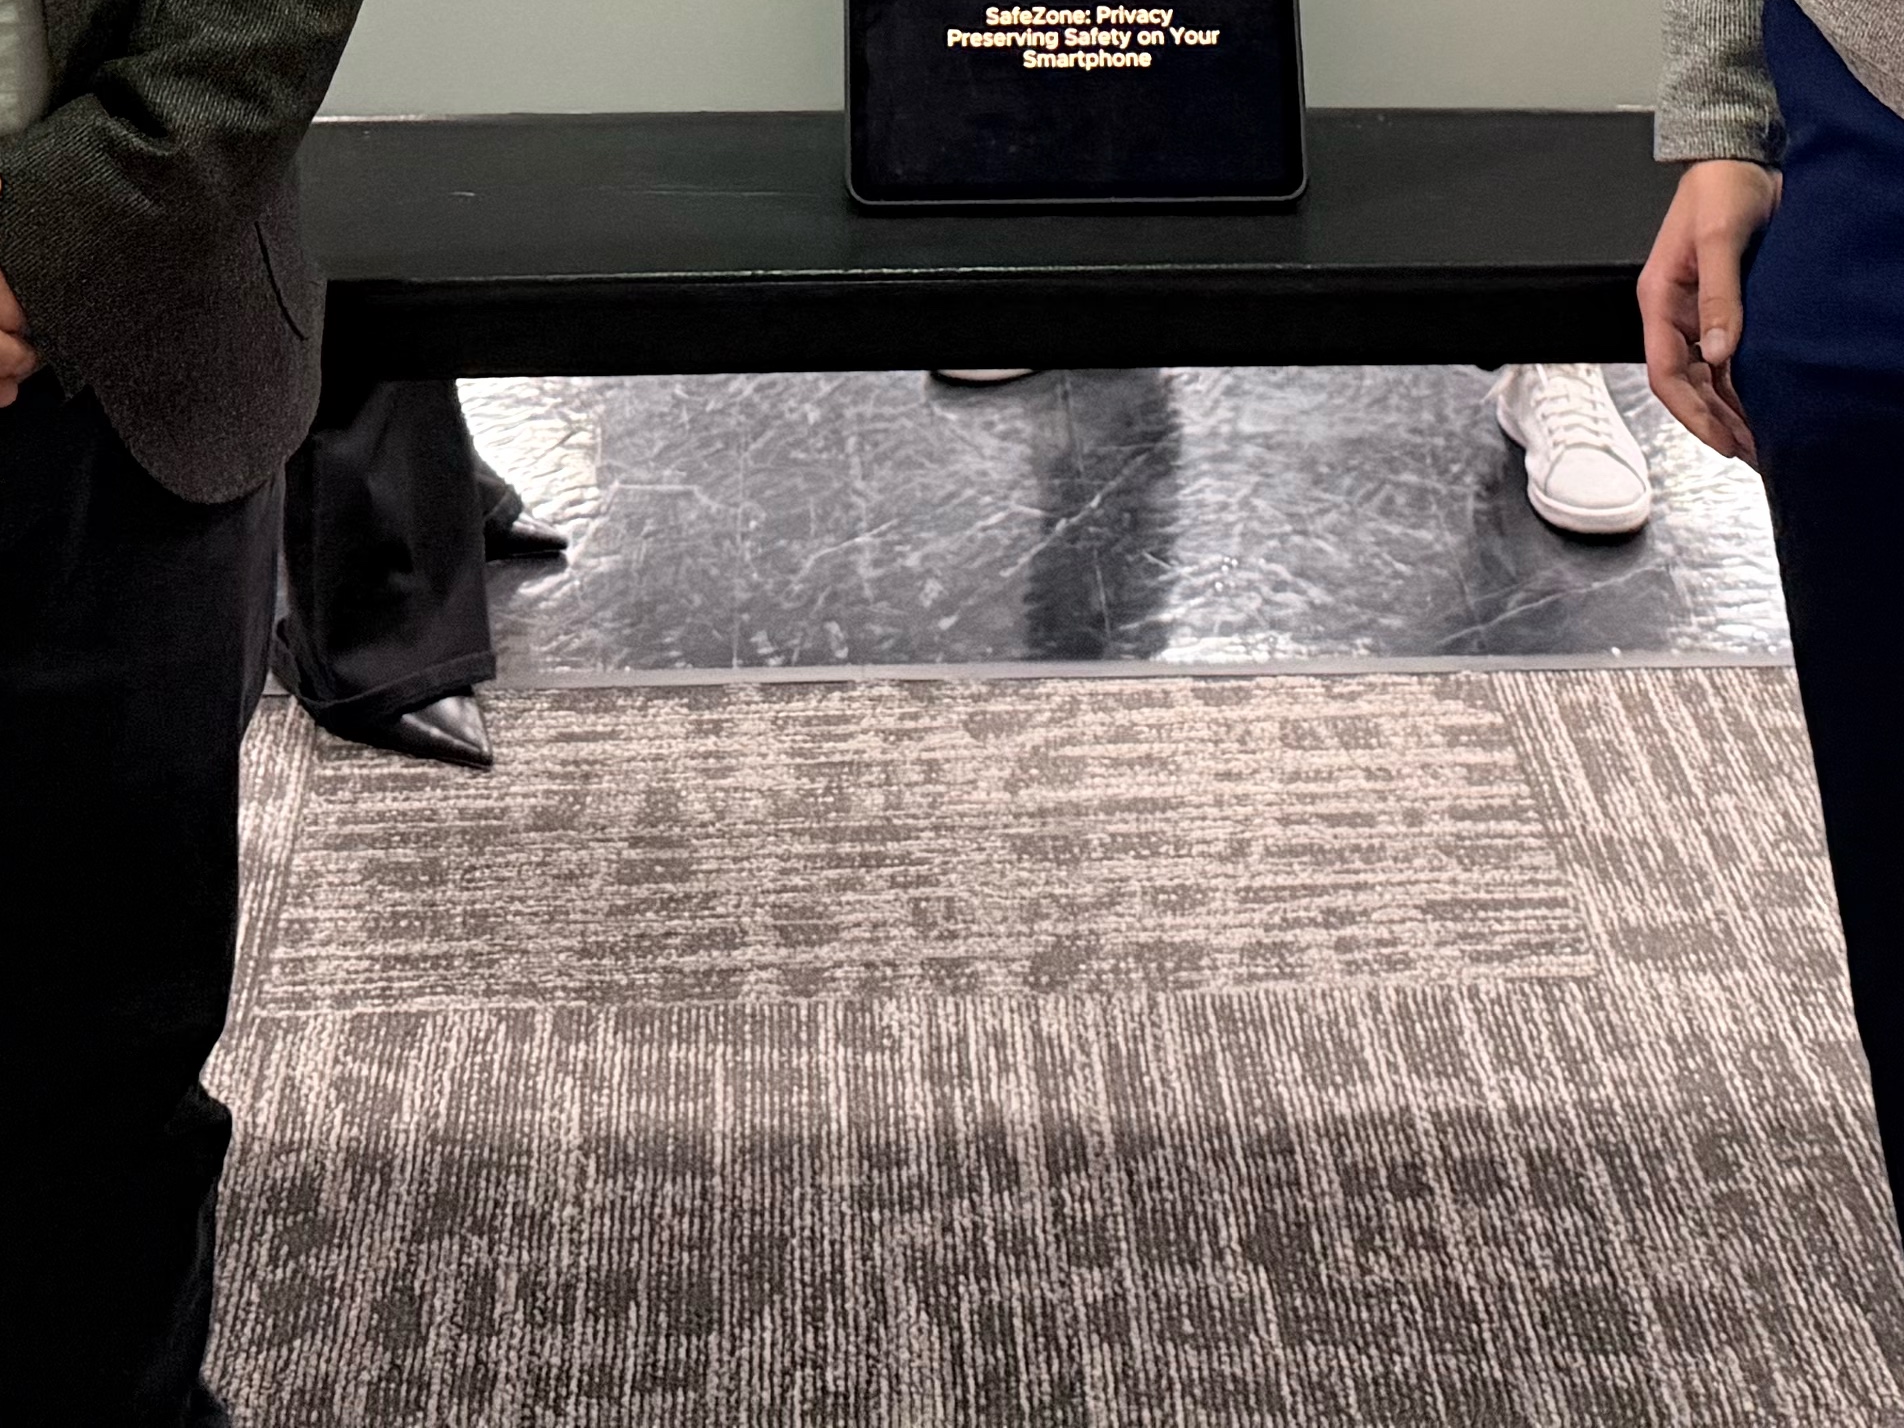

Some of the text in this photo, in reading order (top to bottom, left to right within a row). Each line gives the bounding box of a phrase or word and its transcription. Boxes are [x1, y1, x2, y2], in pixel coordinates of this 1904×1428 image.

[986, 5, 1173, 27] SafeZone: Privacy
[947, 27, 1220, 49] Preserving Safety on Your
[1023, 49, 1152, 71] Smartphone
